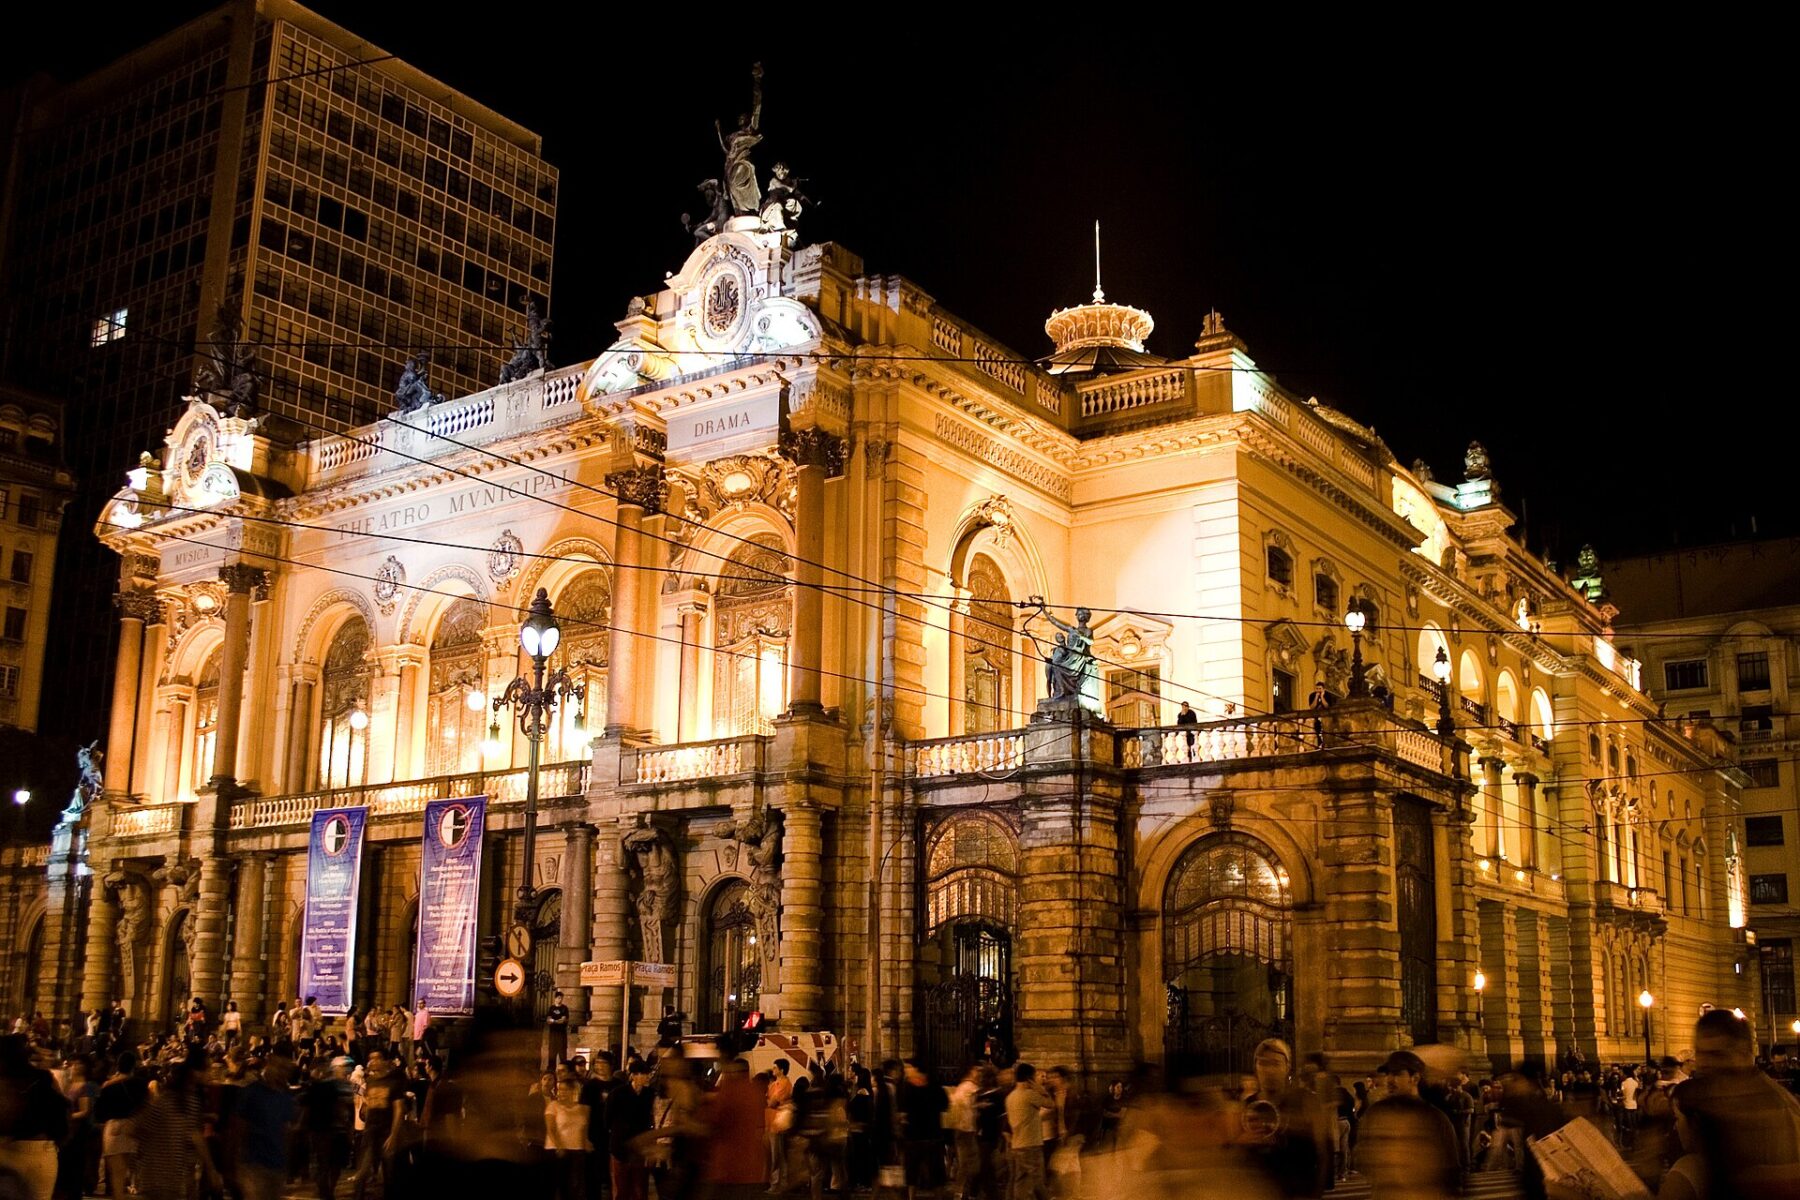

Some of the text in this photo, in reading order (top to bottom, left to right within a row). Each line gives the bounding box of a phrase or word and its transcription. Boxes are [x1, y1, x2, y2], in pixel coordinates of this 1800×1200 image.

[694, 412, 751, 437] DRAMA
[338, 469, 574, 540] THEATRO MVNICIPAL
[175, 547, 210, 566] MVSICA
[600, 962, 621, 972] Ramos
[634, 963, 675, 975] Praça Ramos
